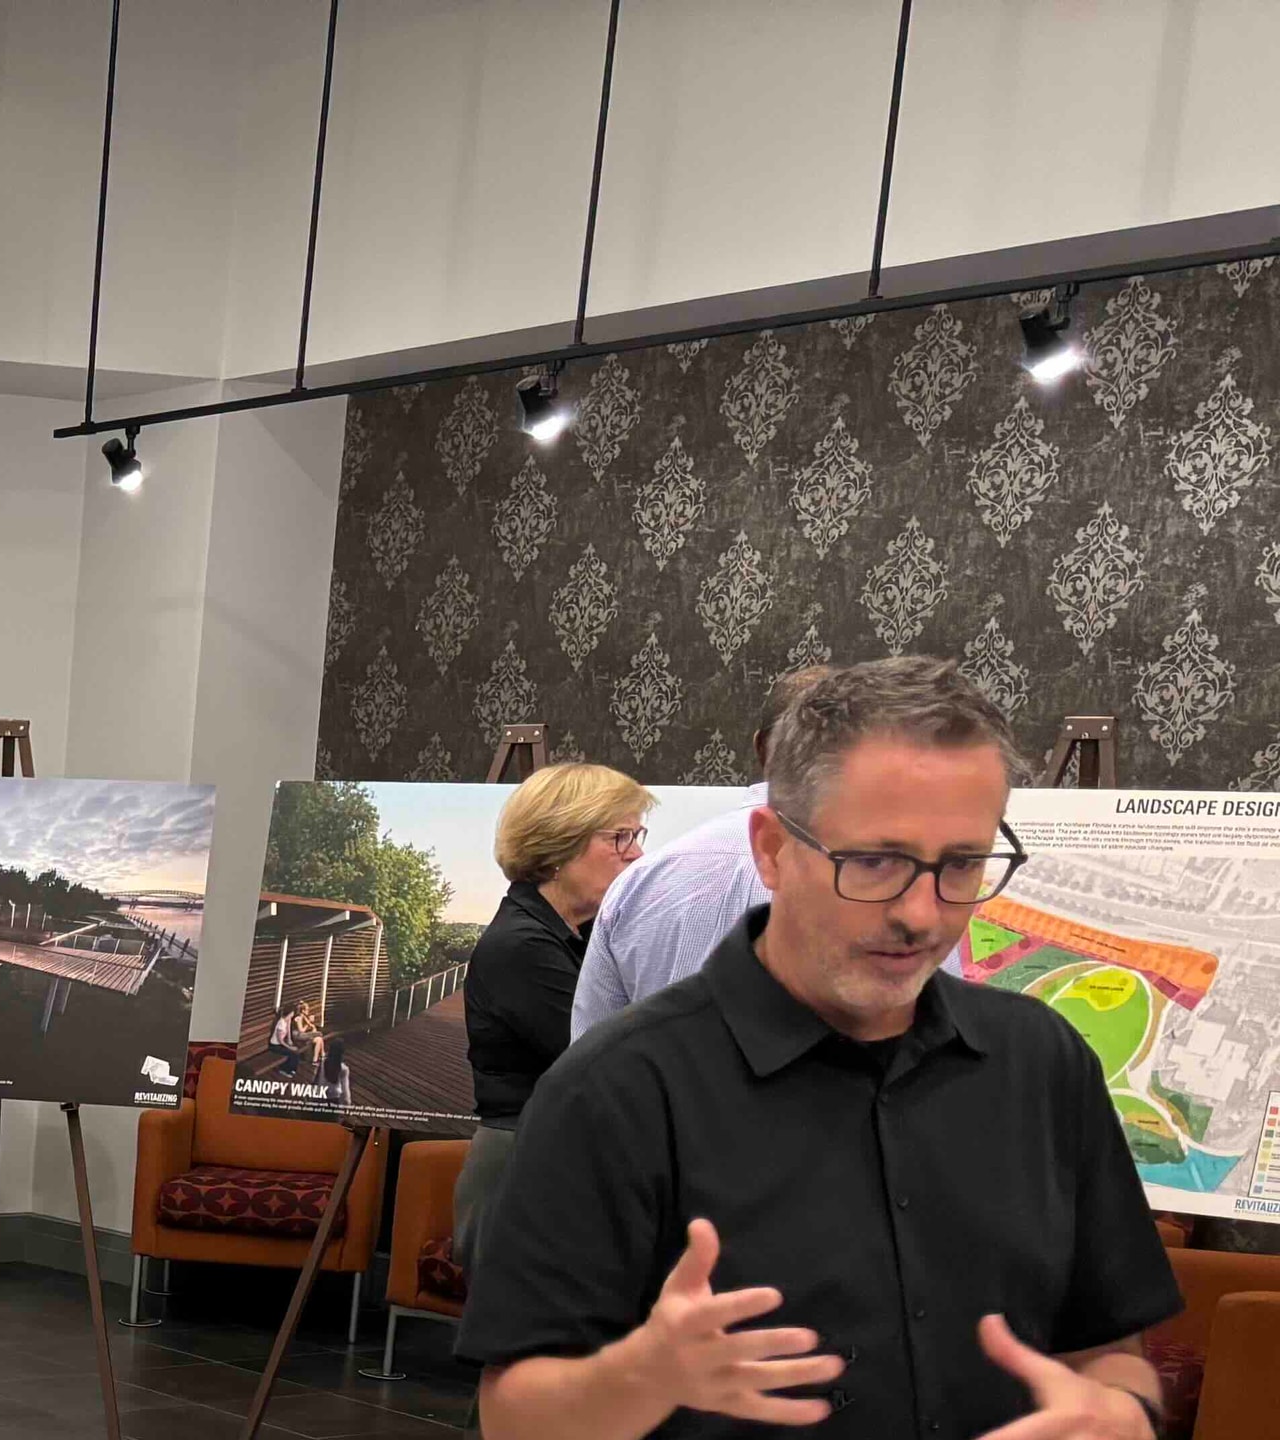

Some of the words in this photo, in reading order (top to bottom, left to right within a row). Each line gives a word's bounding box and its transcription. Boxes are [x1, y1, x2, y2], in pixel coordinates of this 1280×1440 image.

[1115, 798, 1217, 816] LANDSCAPE
[235, 1079, 289, 1096] CANOPY
[291, 1083, 329, 1099] WALK
[1235, 1199, 1280, 1213] REVITALIZ
